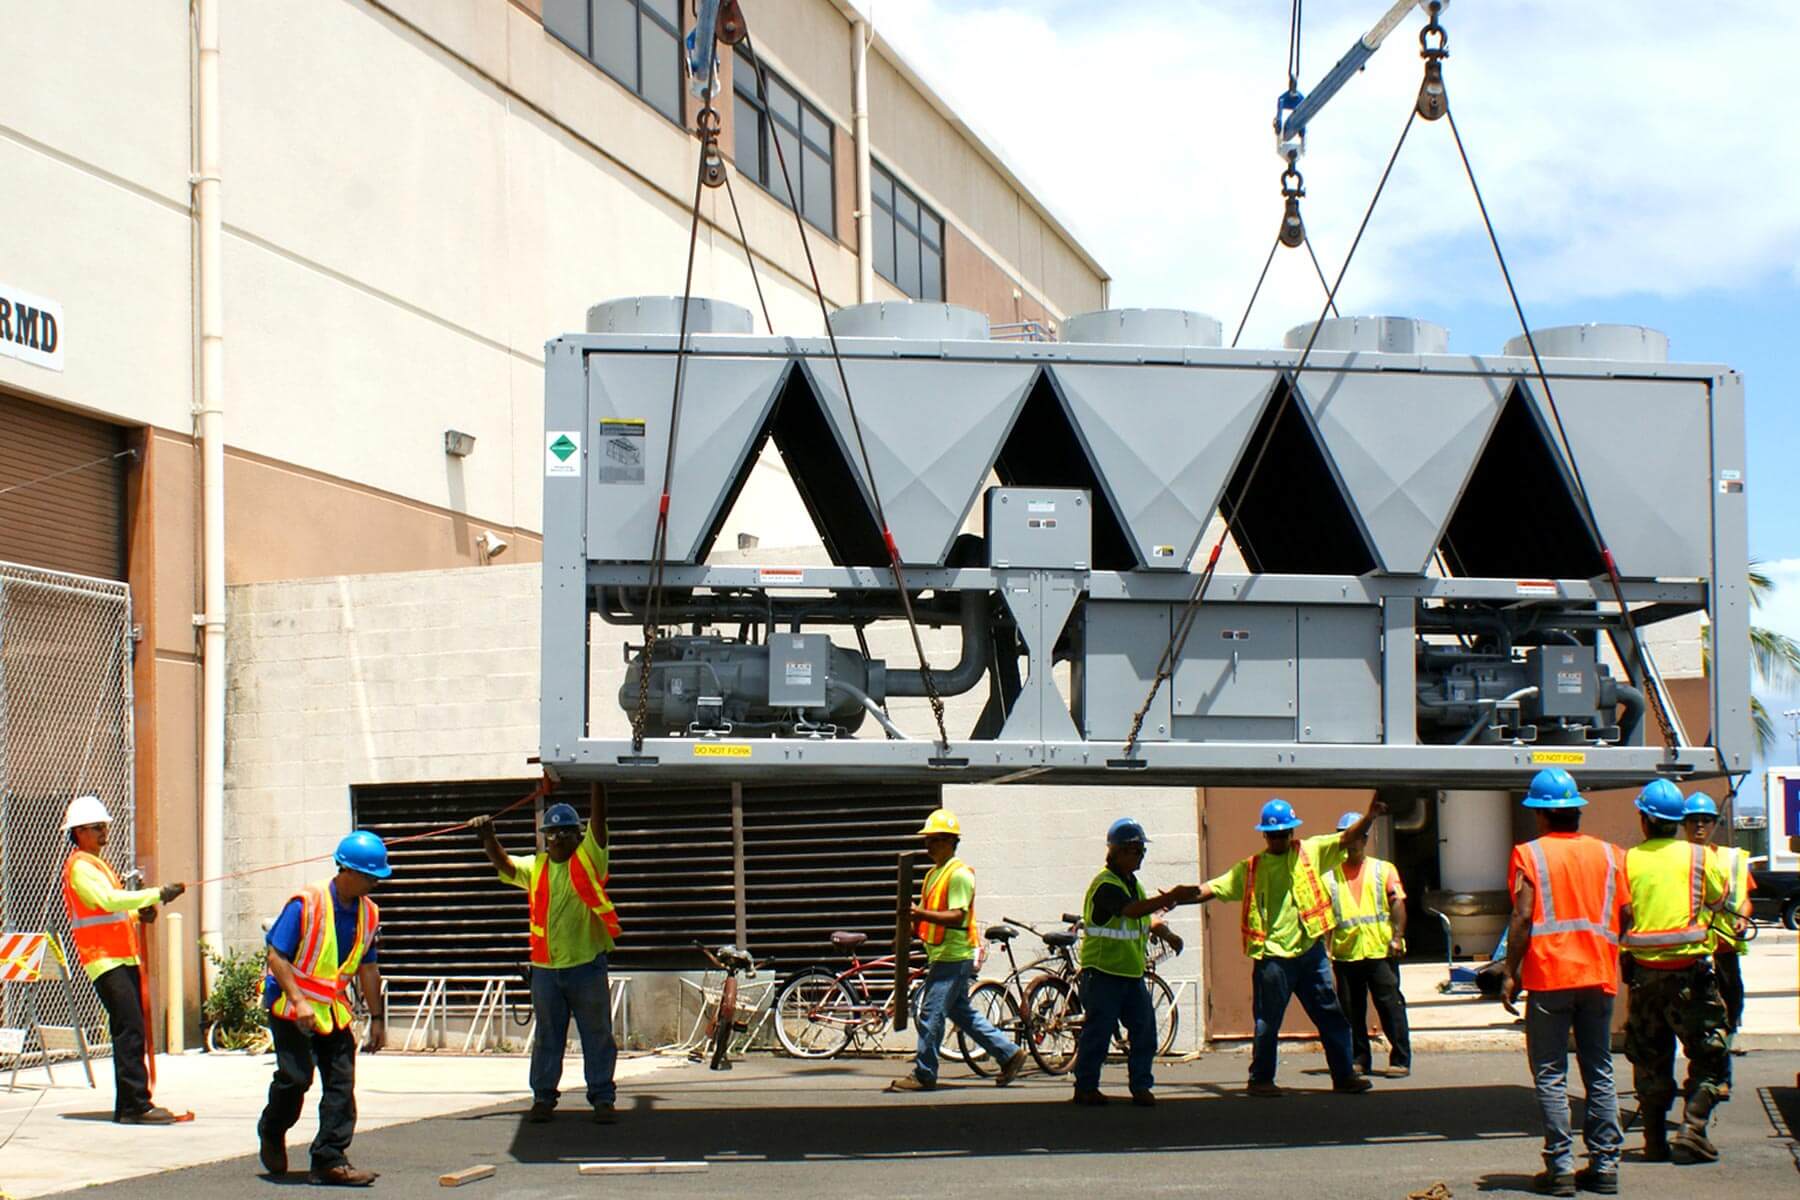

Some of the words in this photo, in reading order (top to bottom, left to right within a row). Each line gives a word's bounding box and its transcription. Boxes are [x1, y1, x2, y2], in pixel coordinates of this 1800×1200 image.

[694, 746, 707, 754] DO
[709, 746, 724, 754] NOT
[727, 746, 749, 754] FORK
[1563, 754, 1584, 762] FORK
